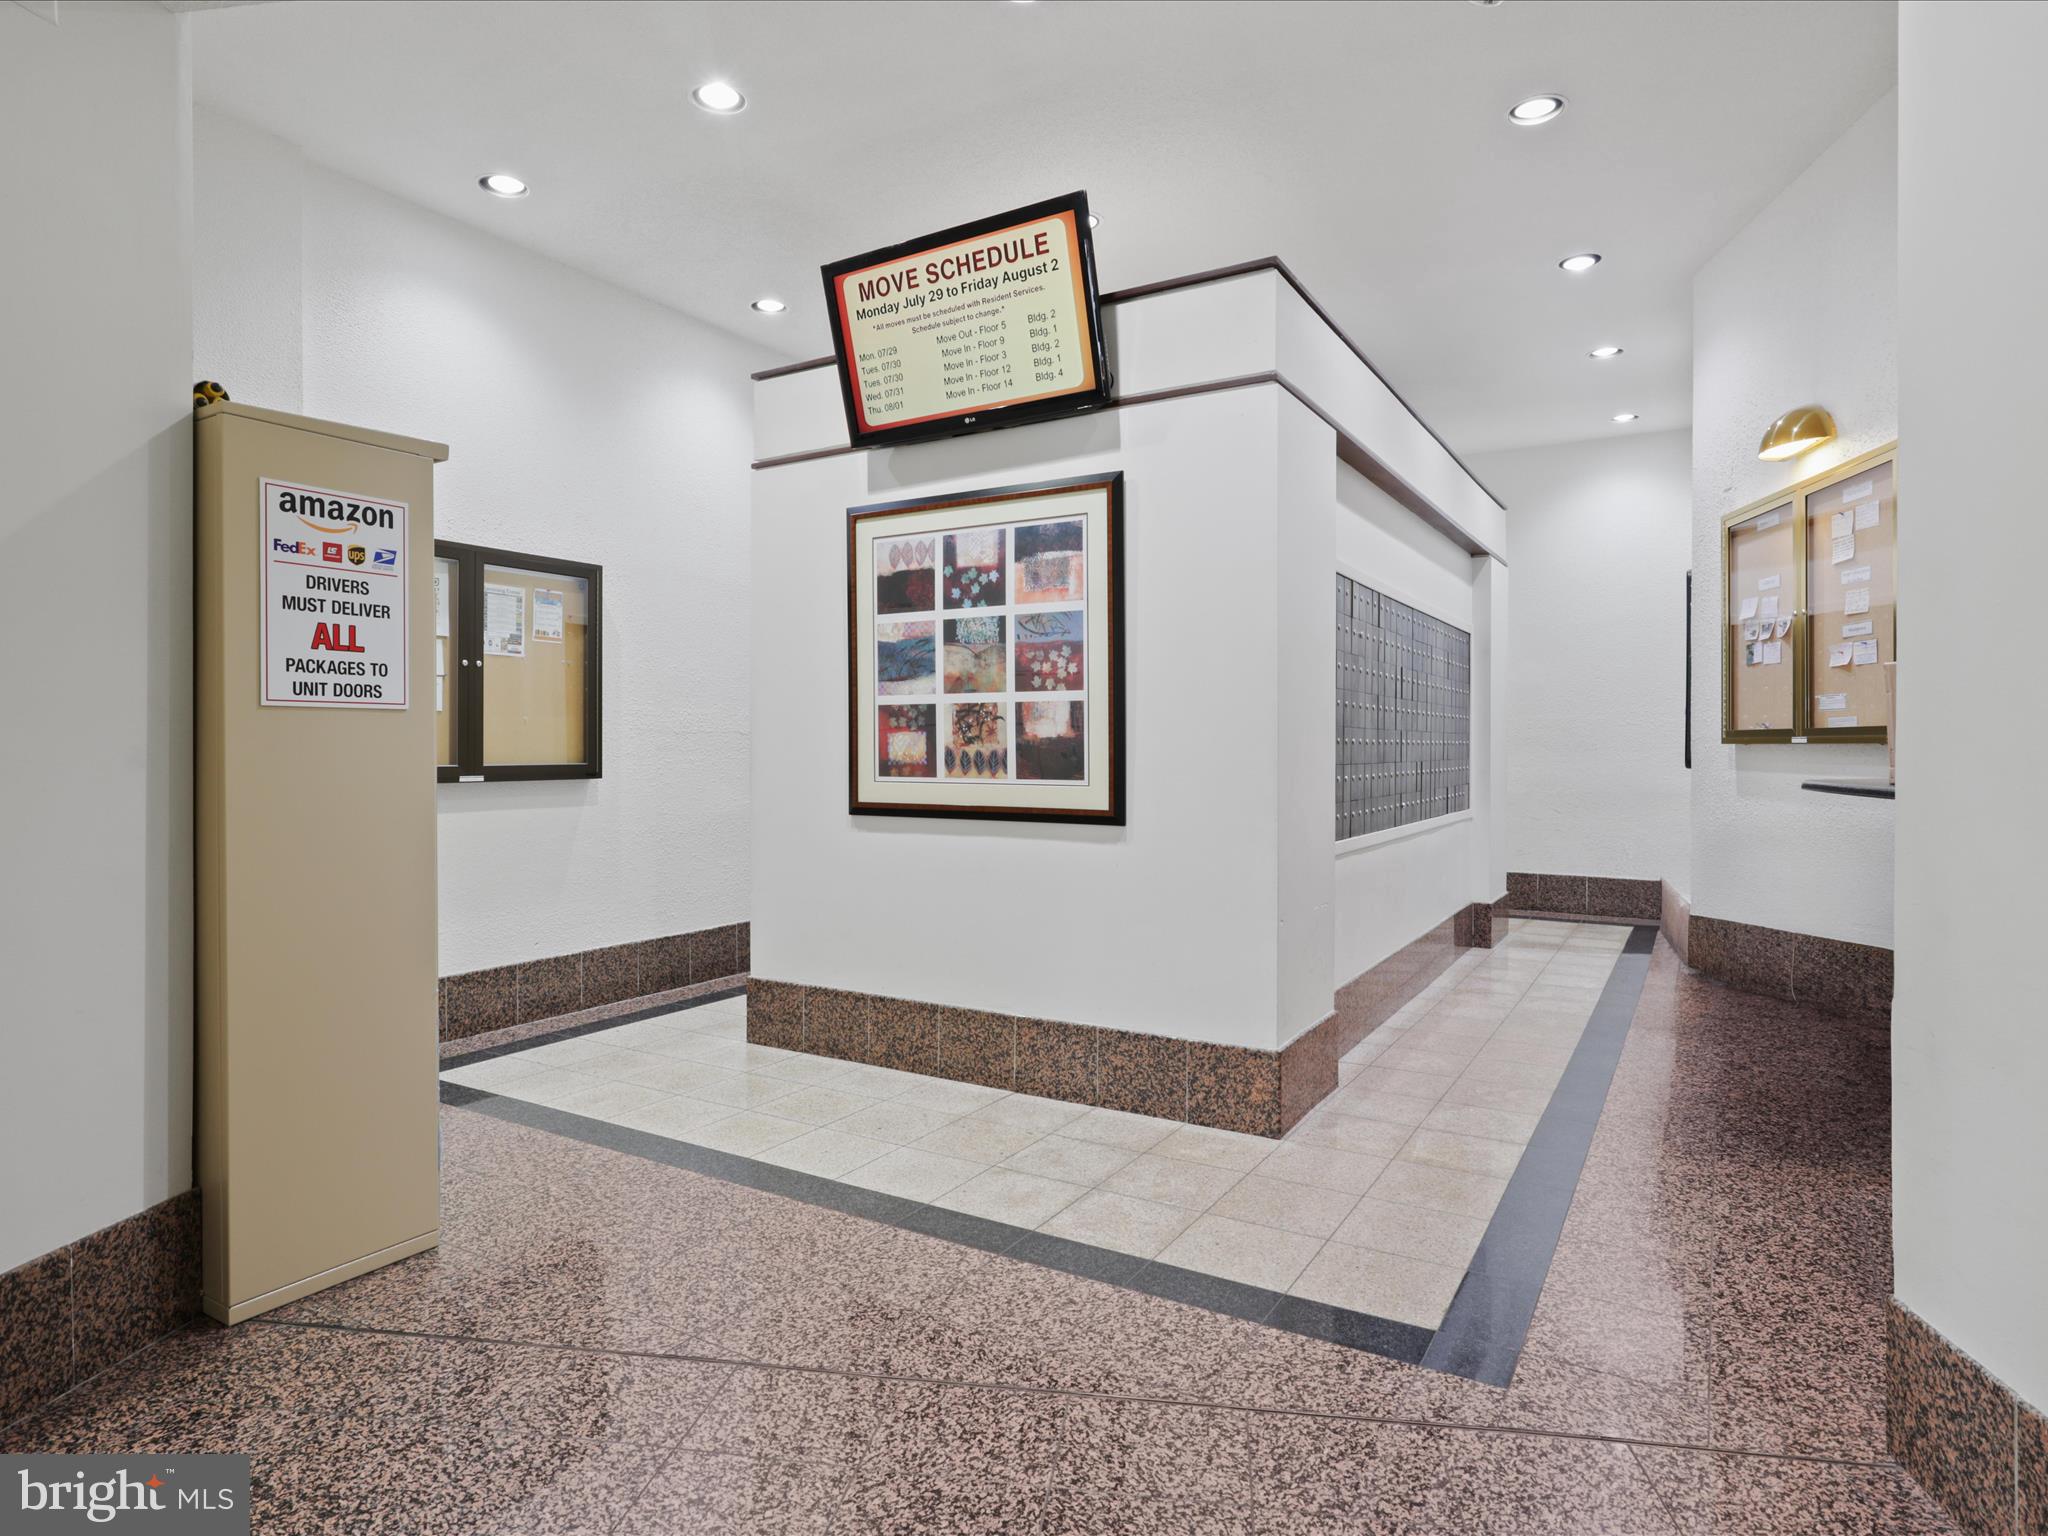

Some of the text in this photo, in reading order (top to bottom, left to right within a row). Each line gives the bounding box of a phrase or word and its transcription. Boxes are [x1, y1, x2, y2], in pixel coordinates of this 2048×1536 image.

[858, 232, 1050, 302] MOVE SCHEDULE
[856, 259, 1059, 320] Monday July 29 to Friday August 2
[885, 319, 906, 328] moves
[906, 314, 922, 324] must
[922, 312, 931, 321] be
[932, 303, 966, 319] scheduled
[966, 300, 981, 309] with
[982, 292, 1012, 305] Resident
[1013, 285, 1046, 298] Services.
[877, 346, 897, 358] 07/29
[936, 333, 957, 345] Move
[958, 328, 975, 340] Out
[979, 323, 999, 336] Floor
[1001, 320, 1007, 329] 5
[1027, 313, 1048, 324] Bldg.
[1050, 309, 1056, 319] 2
[912, 322, 941, 335] Schedule
[942, 315, 966, 329] subject
[967, 313, 974, 321] to
[881, 359, 901, 371] 07/30
[942, 346, 962, 358] Move
[963, 344, 971, 353] In
[977, 338, 997, 350] Floor
[999, 335, 1005, 345] 9
[1029, 327, 1050, 338] Bldg.
[1053, 324, 1057, 333] 1
[883, 372, 904, 384] 07/30
[943, 360, 964, 372] Move
[965, 358, 973, 367] In
[979, 352, 999, 364] Floor
[1001, 350, 1007, 359] 3
[1031, 342, 1052, 353] Bldg.
[1054, 338, 1060, 348] 2
[884, 387, 904, 398] 07/31
[943, 374, 964, 386] Move
[965, 372, 973, 381] In
[979, 367, 999, 379] Floor
[1002, 364, 1011, 374] 12
[1033, 357, 1054, 367] Bldg.
[1057, 354, 1061, 362] 1
[884, 401, 904, 412] 08/01
[945, 388, 966, 400] Move
[967, 386, 976, 396] In
[981, 381, 1001, 393] Floor
[1003, 378, 1013, 389] 14
[1035, 371, 1056, 382] Bldg.
[1058, 368, 1063, 377] 4
[279, 491, 394, 529] amazon
[273, 538, 316, 556] FedEx
[348, 550, 365, 562] ups
[306, 575, 369, 595] DRIVERS
[282, 595, 391, 619] MUST DELIVER
[311, 622, 365, 653] ALL
[285, 658, 388, 677] PACKAGES TO
[292, 681, 382, 699] UNIT DOORS
